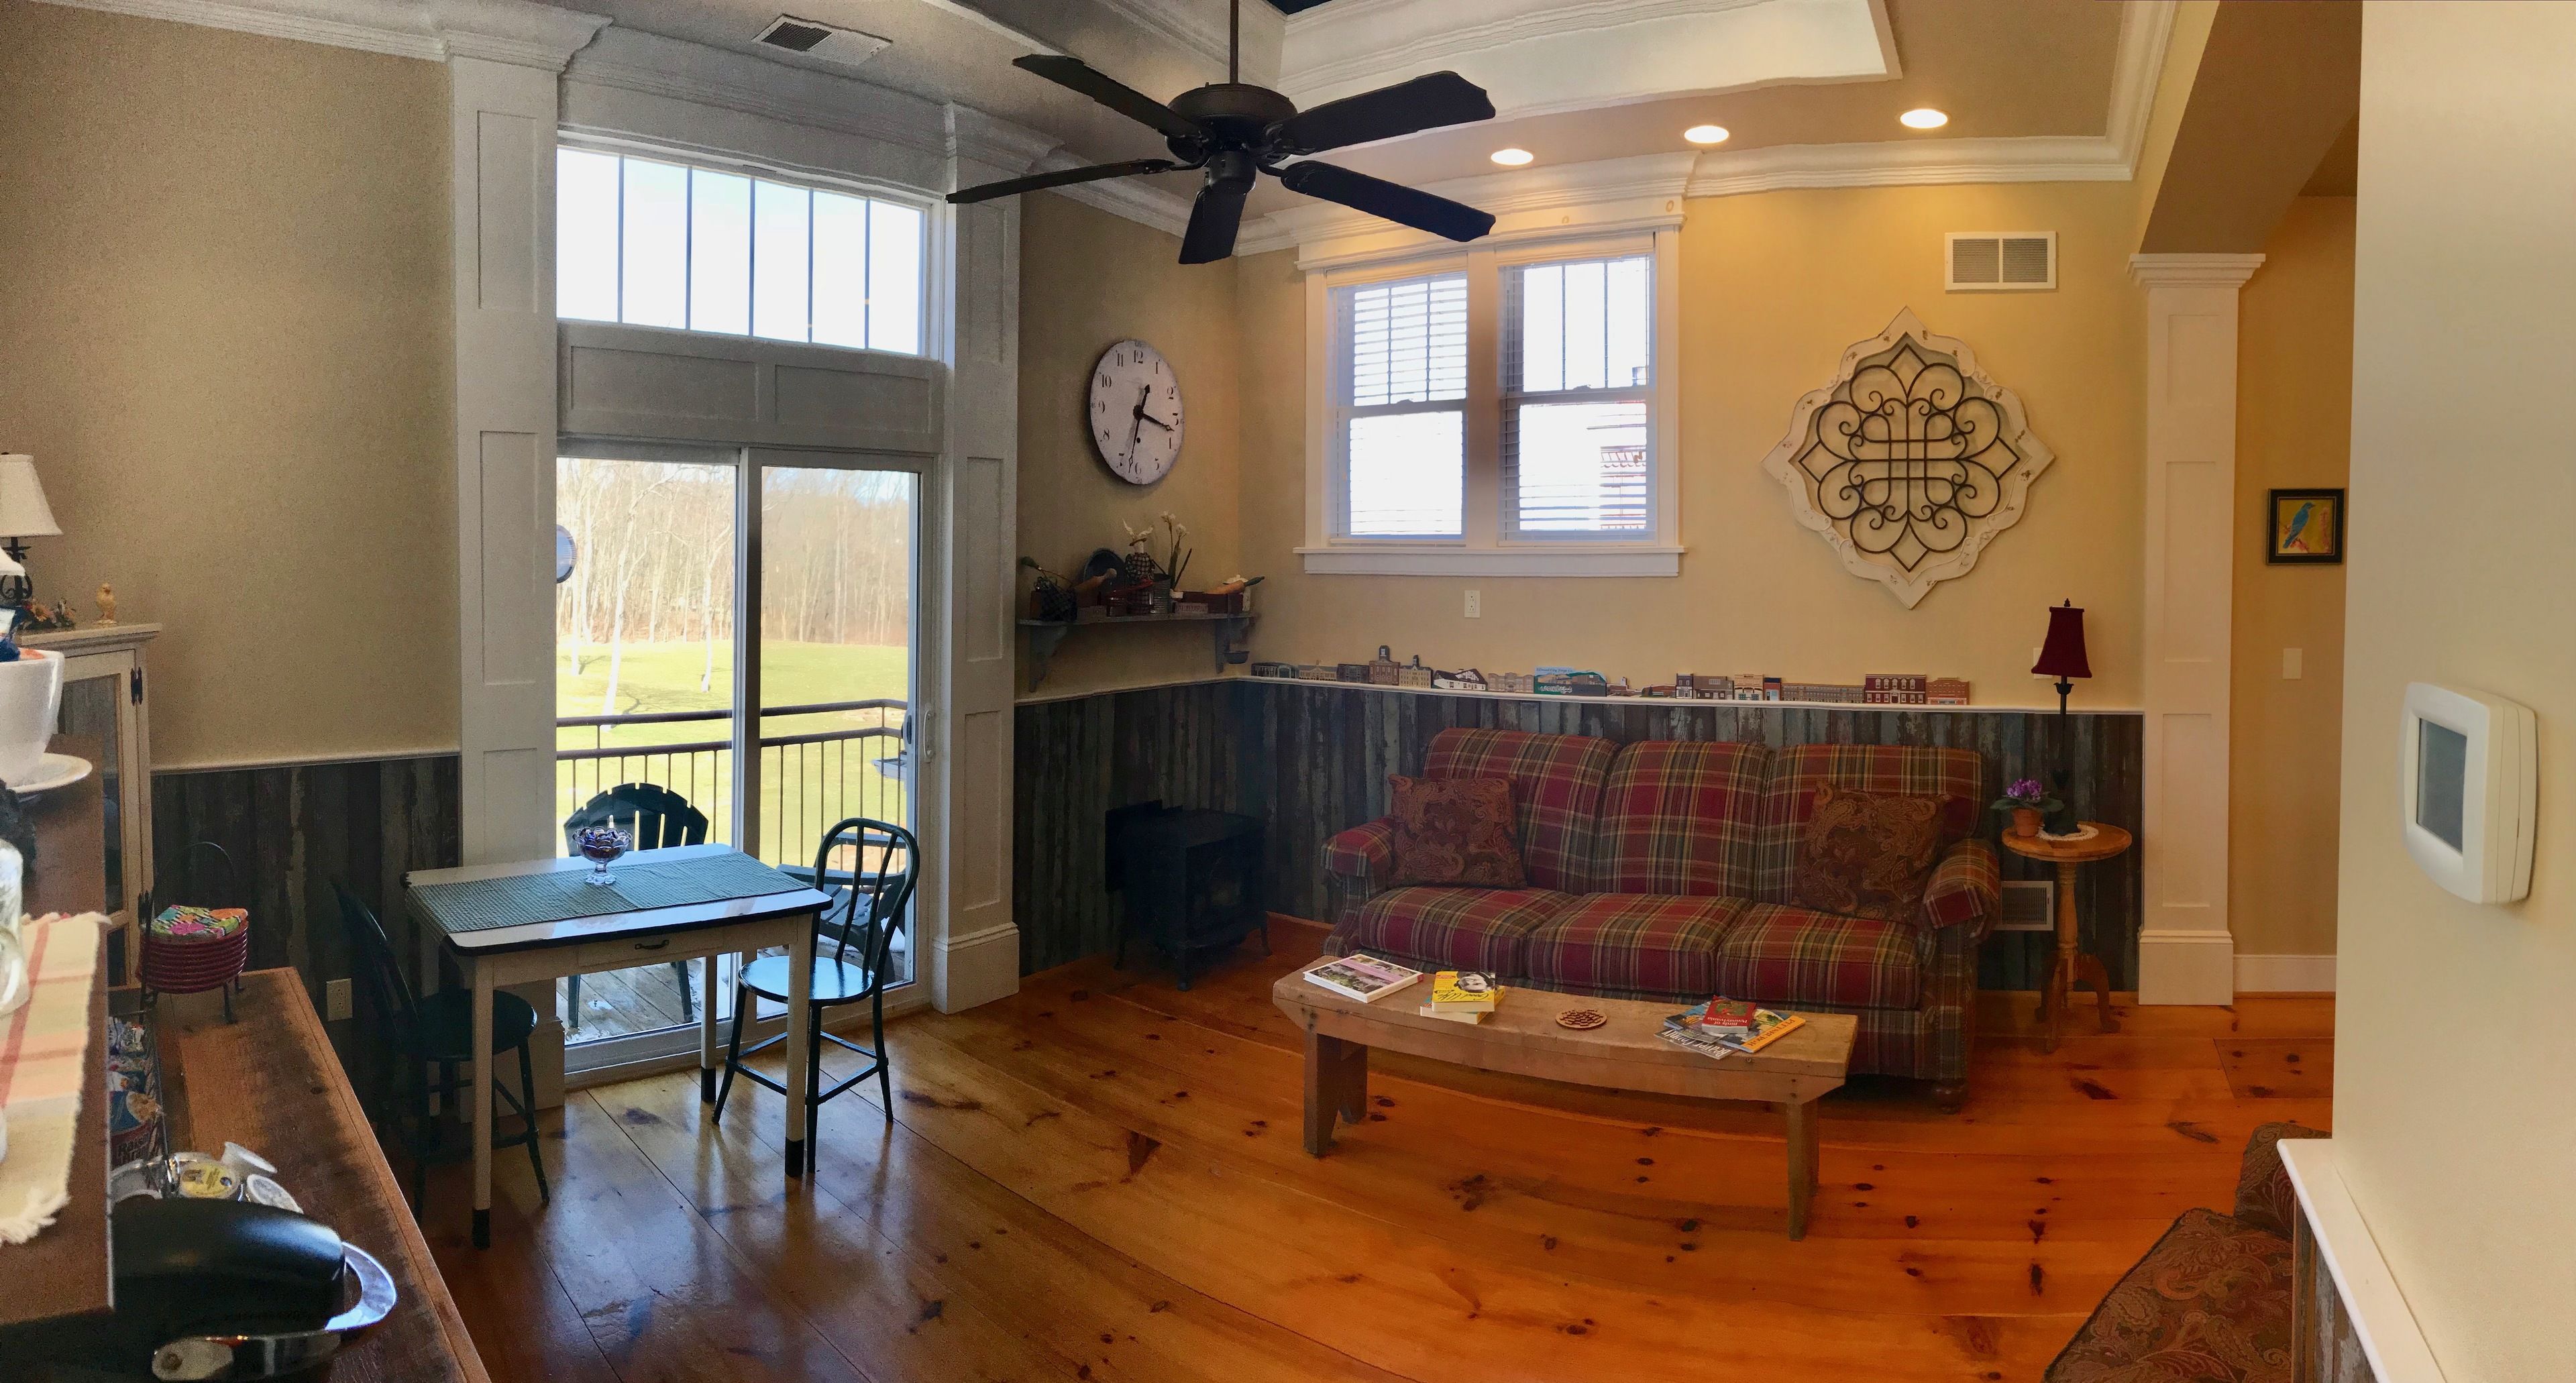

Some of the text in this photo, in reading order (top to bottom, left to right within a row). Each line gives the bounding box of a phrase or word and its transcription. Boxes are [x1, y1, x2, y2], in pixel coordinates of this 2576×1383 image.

[1117, 353, 1124, 367] 11
[1134, 349, 1143, 364] 12
[1102, 374, 1112, 388] 10
[1167, 386, 1174, 400] 2
[1102, 428, 1110, 441] 8
[1662, 1029, 1731, 1058] Beaver County
